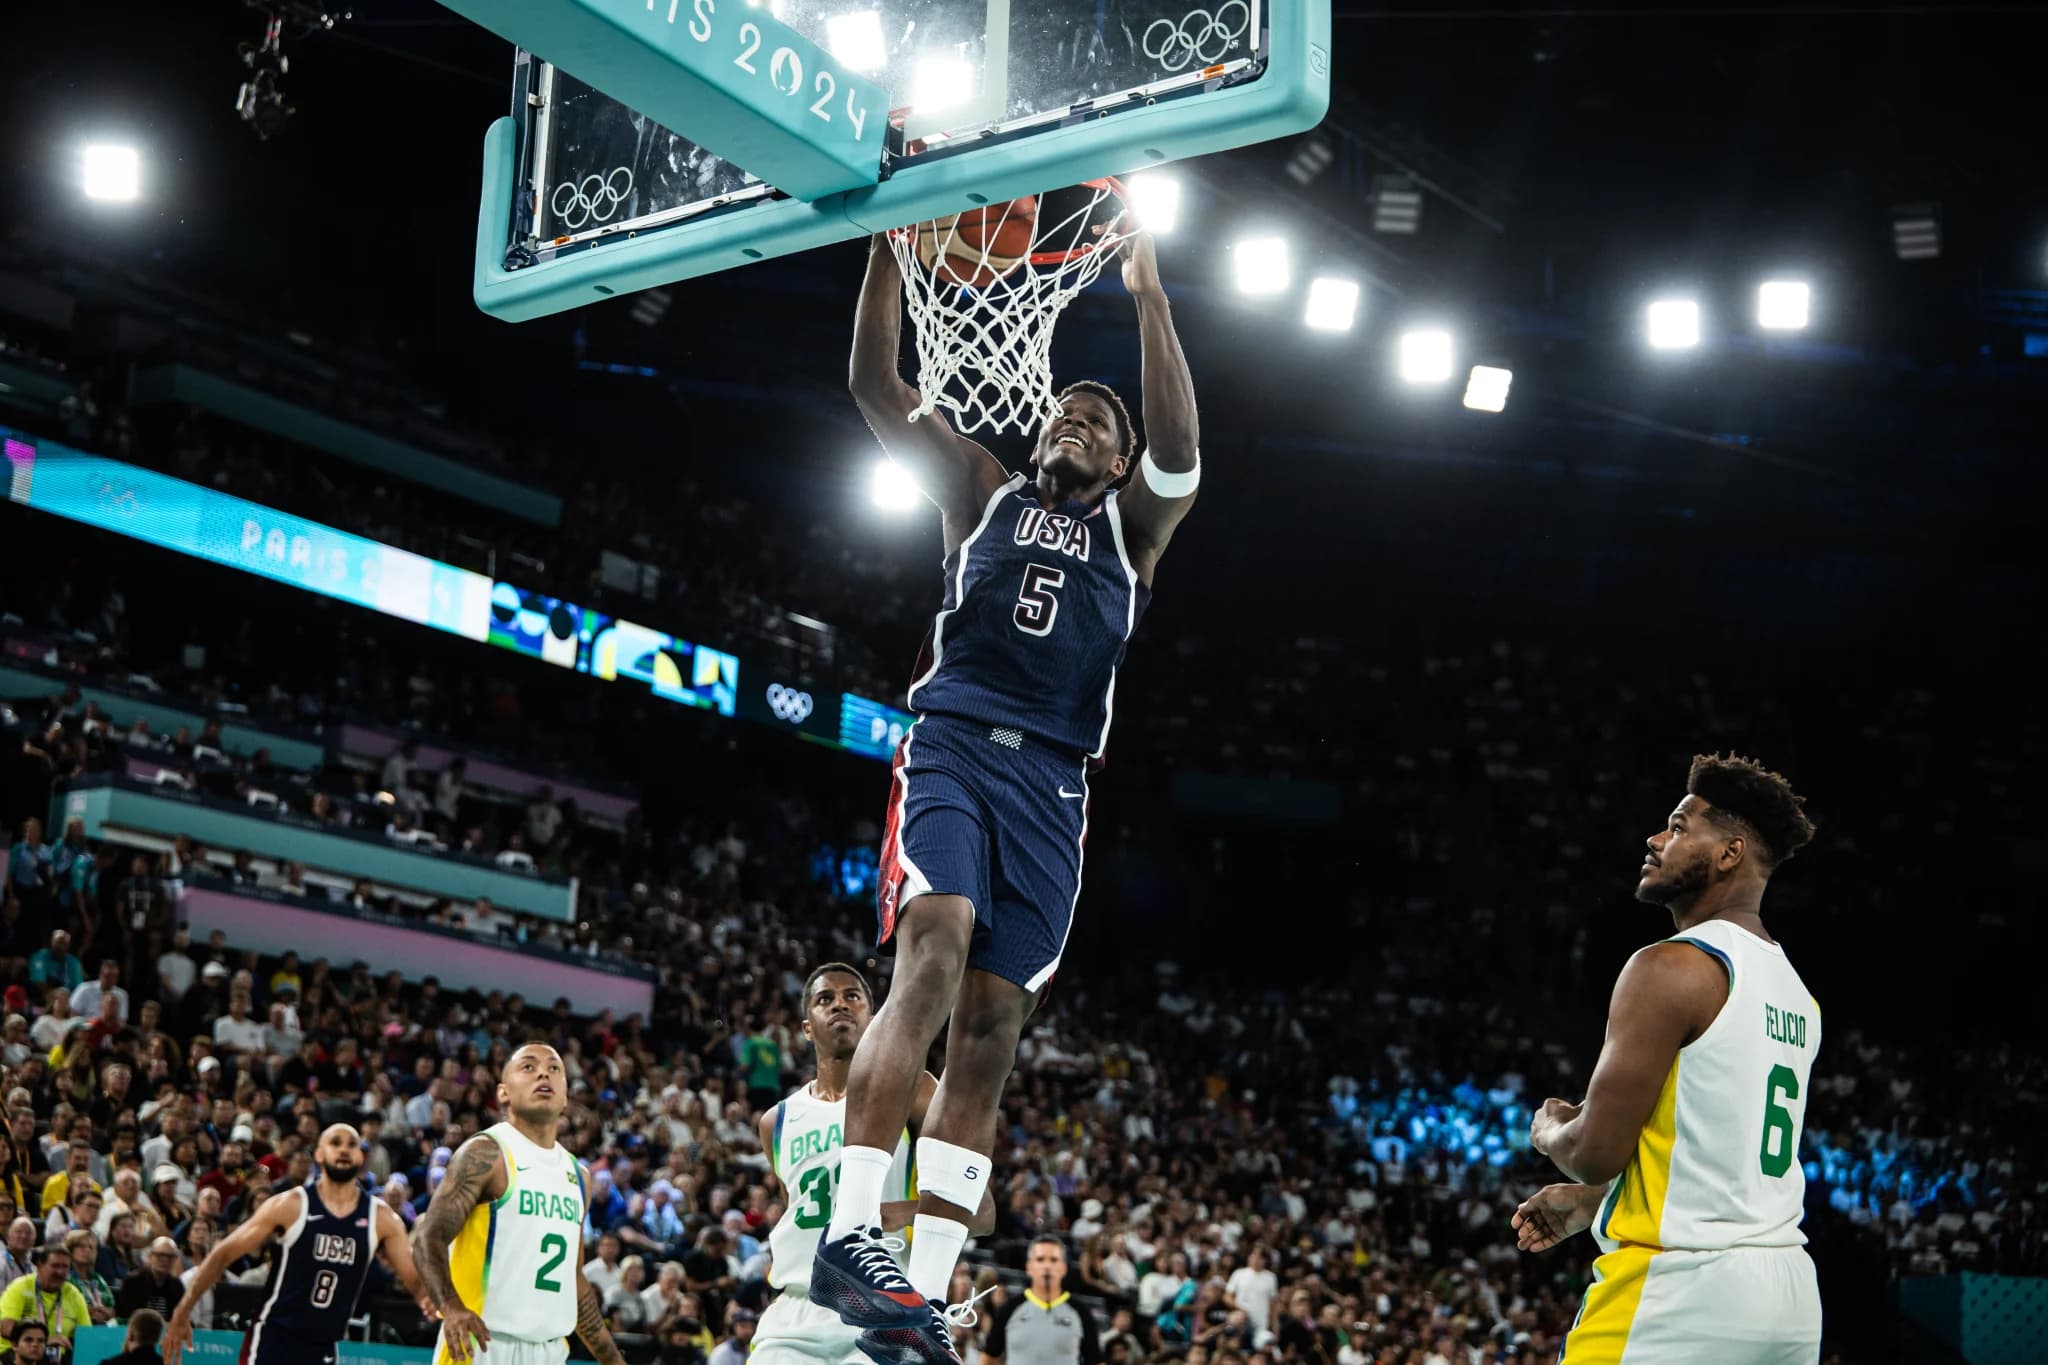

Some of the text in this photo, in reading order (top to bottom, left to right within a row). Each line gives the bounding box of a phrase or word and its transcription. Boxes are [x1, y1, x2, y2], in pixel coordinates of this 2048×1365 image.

[733, 22, 867, 141] 2024
[241, 519, 348, 582] PARIS
[1014, 507, 1090, 562] USA
[1013, 562, 1065, 637] 5
[1765, 1002, 1806, 1049] FELICIO
[1760, 1063, 1799, 1179] 6
[963, 1165, 980, 1180] 5
[518, 1188, 582, 1225] BRASIL
[313, 1232, 357, 1266] USA
[534, 1232, 568, 1293] 2
[311, 1269, 339, 1309] 8
